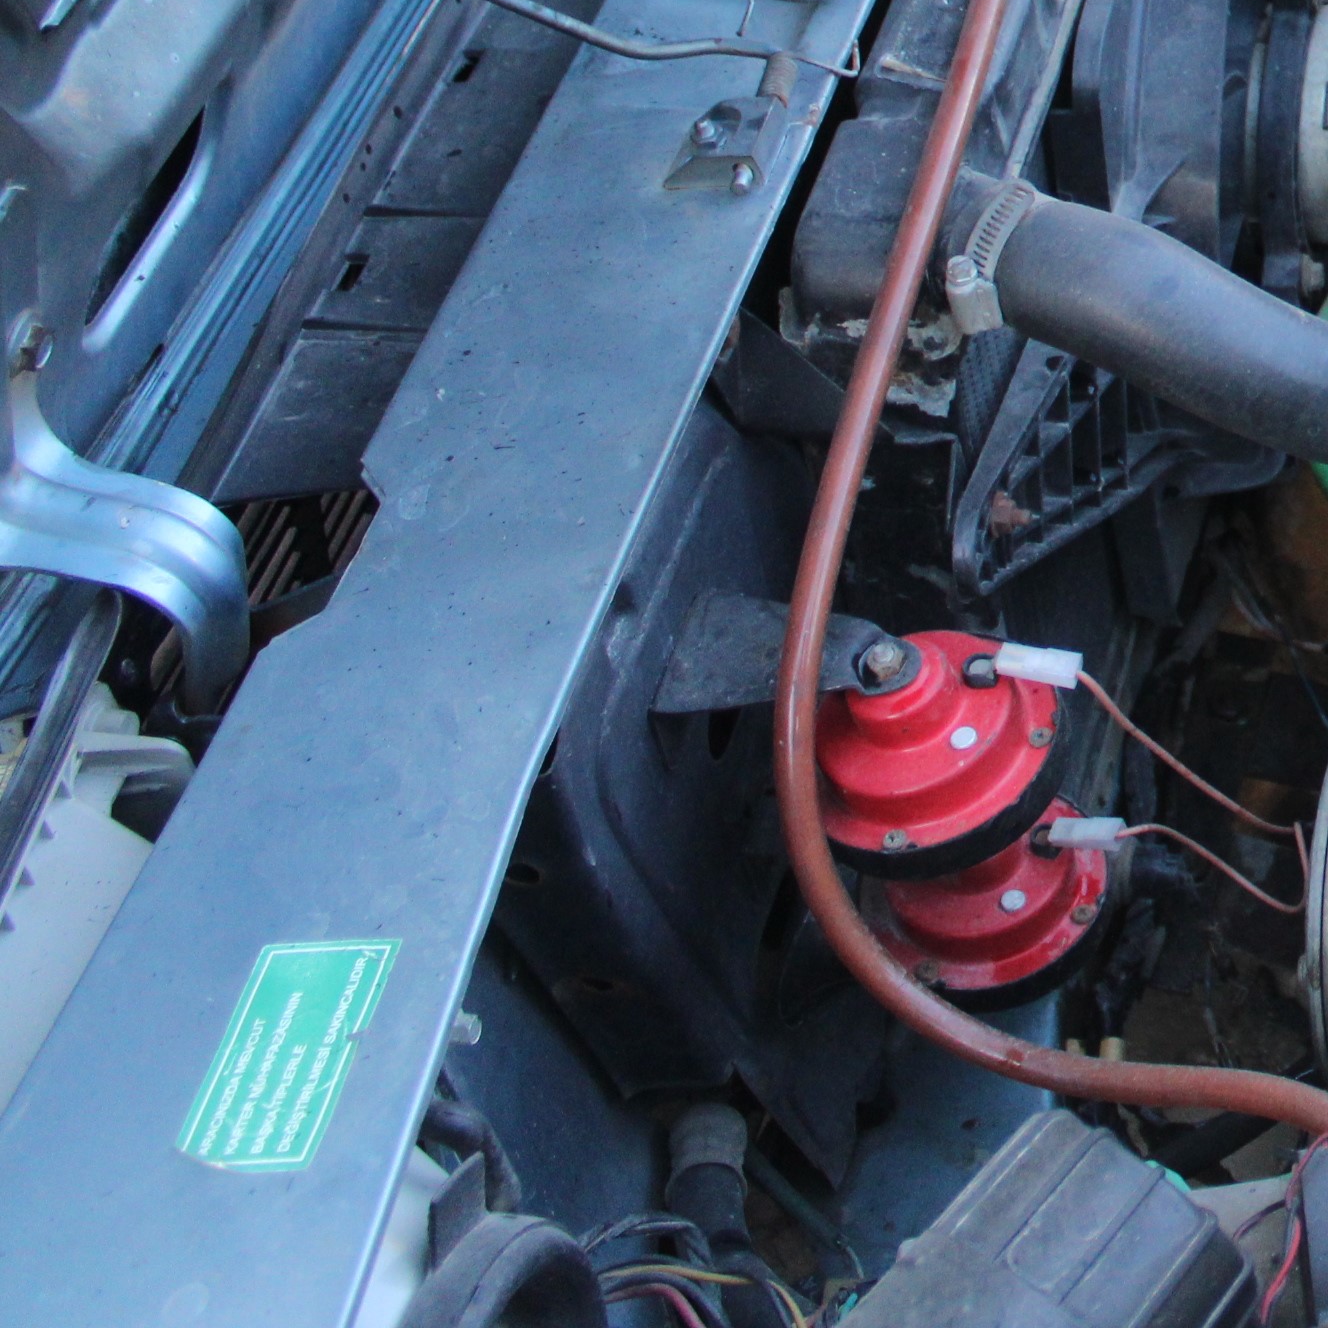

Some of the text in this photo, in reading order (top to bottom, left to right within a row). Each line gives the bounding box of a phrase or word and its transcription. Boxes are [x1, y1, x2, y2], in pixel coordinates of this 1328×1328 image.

[198, 1017, 267, 1156] ARACINIZDA MEVCUT
[223, 1100, 258, 1156] KARTER
